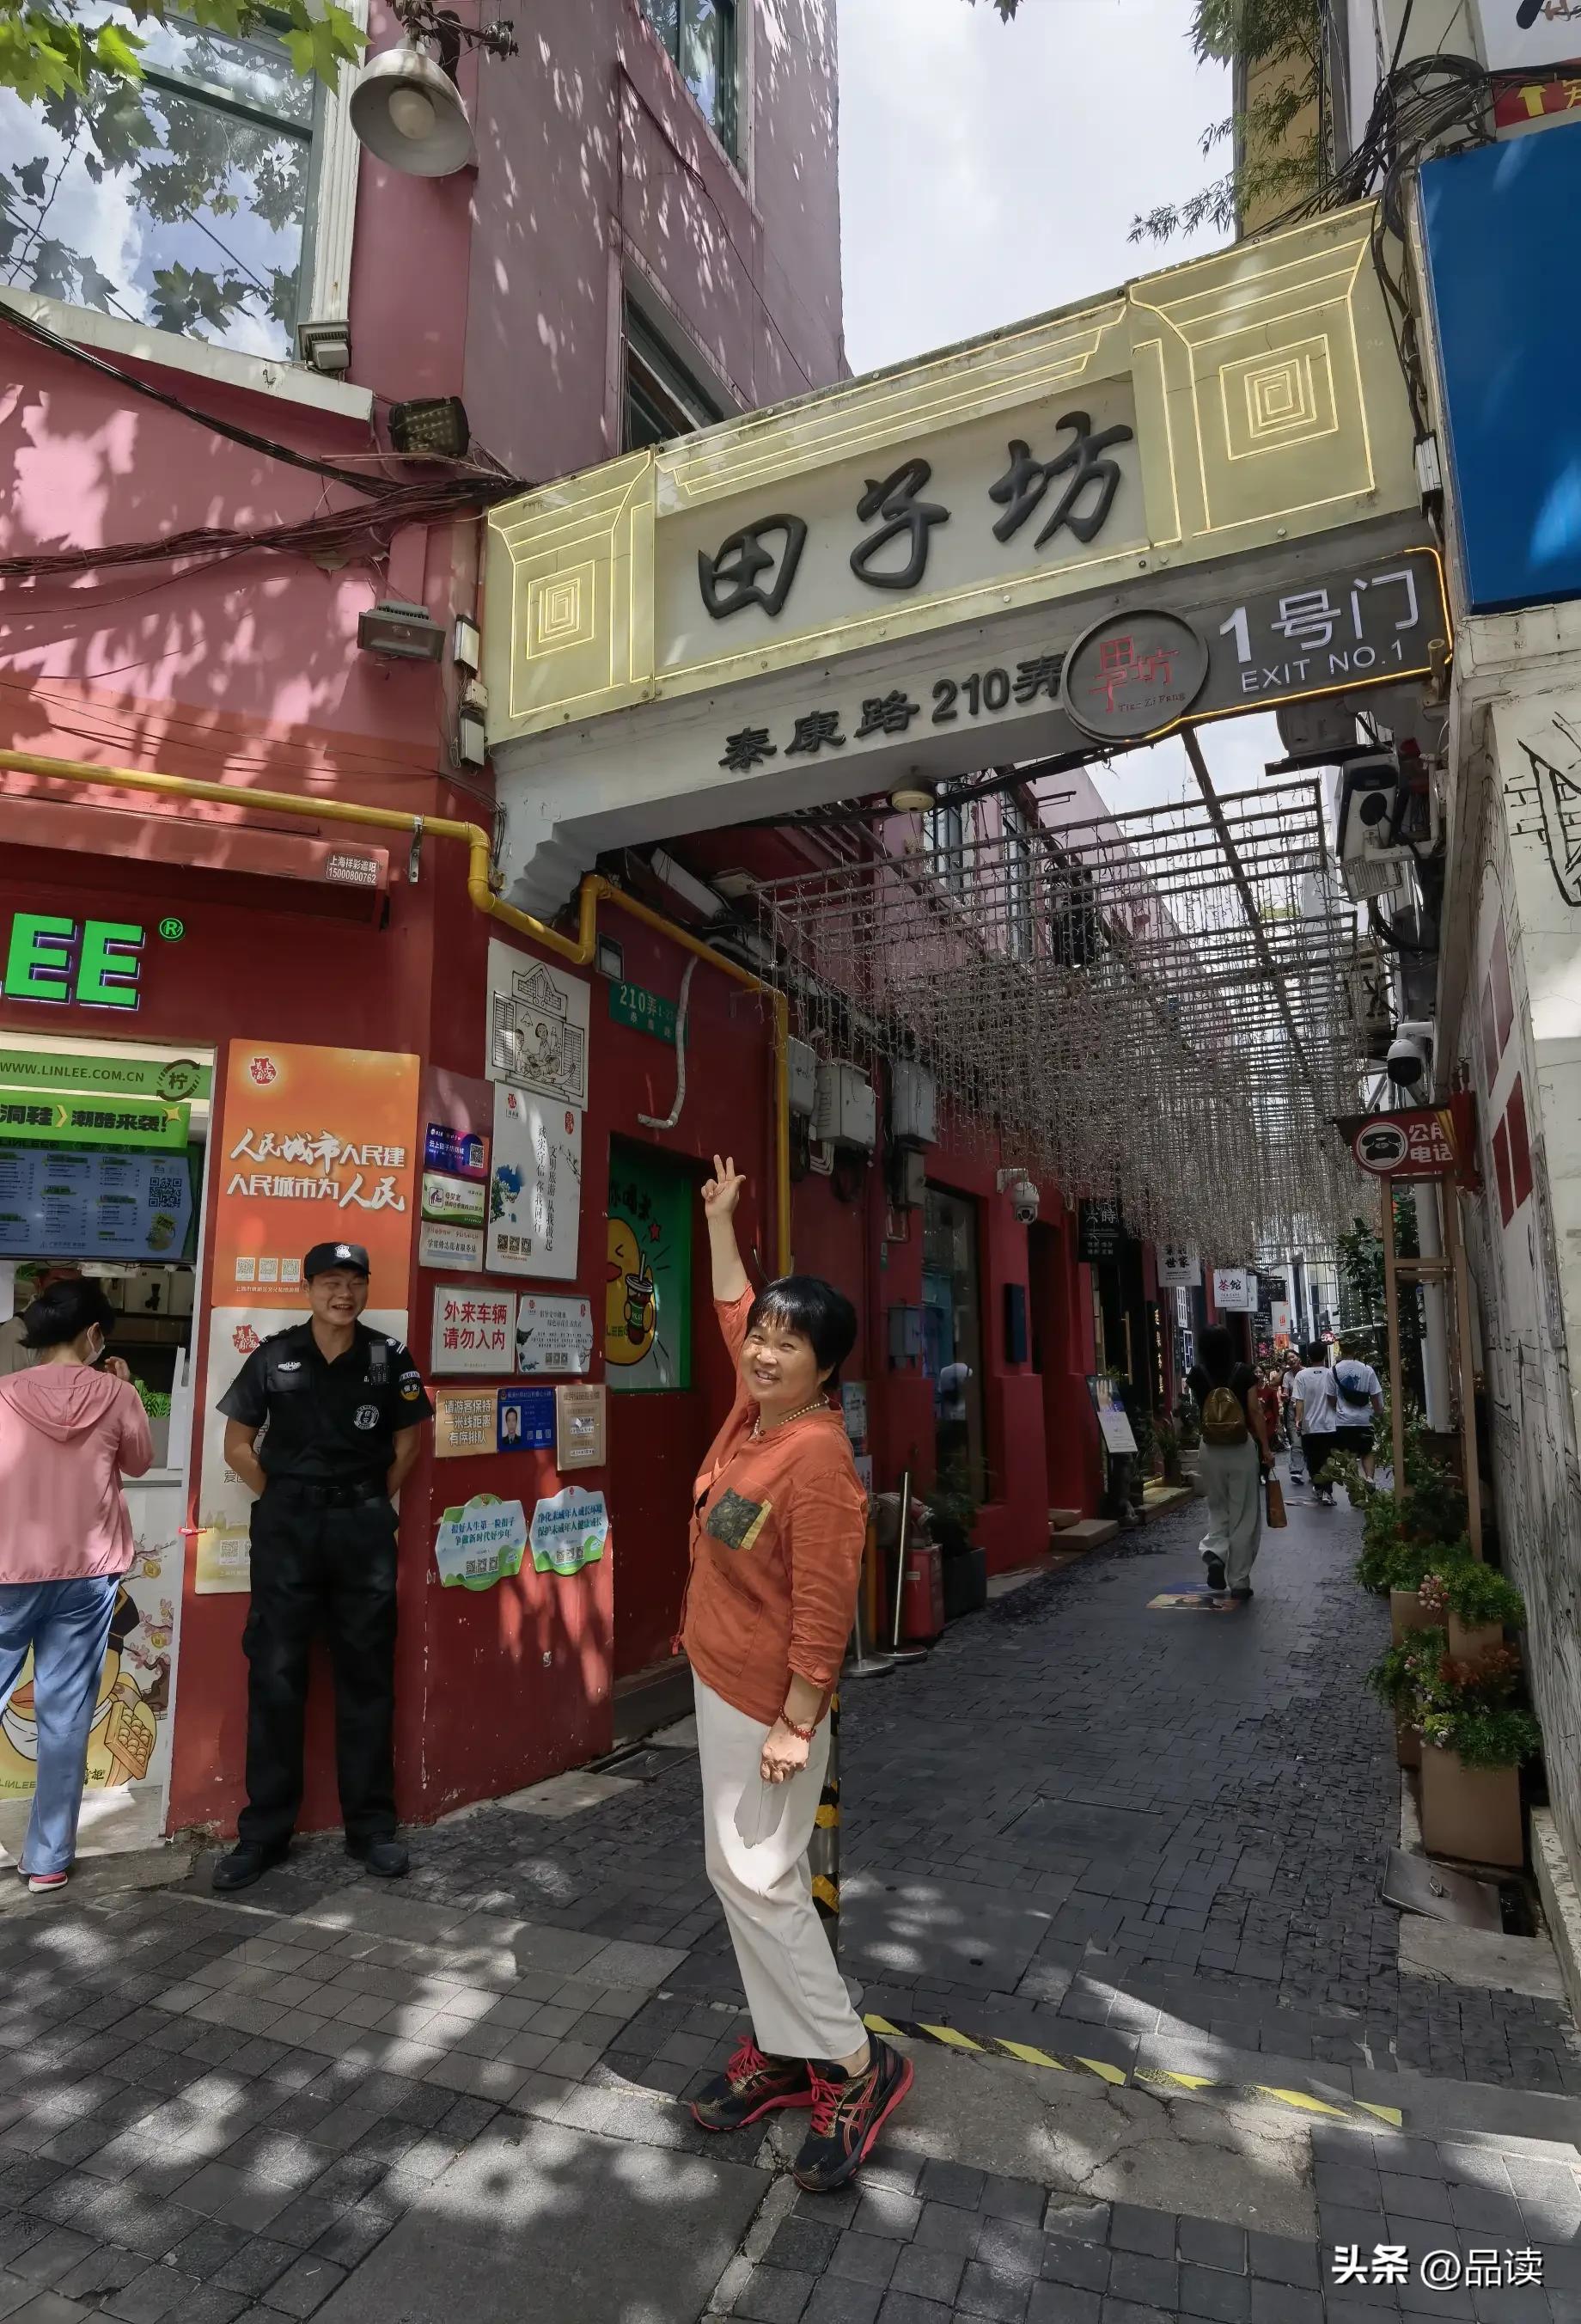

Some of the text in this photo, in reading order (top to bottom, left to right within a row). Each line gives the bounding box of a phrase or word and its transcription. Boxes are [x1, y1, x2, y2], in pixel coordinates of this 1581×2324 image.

[698, 410, 1133, 620] 田子坊
[1219, 569, 1419, 664] 1号门
[1242, 639, 1402, 693] EXIT NO.1
[718, 651, 1068, 771] 泰康路210弄
[329, 867, 376, 884] 15000800762
[0, 1061, 144, 1083] WWW.LINLEE.COM.CN
[229, 1128, 405, 1175] 人民城市人民建
[1410, 1143, 1453, 1163] 电话
[227, 1172, 405, 1211] 人民城市为人民
[444, 1300, 508, 1325] 外来车辆
[443, 1327, 505, 1350] 请勿入内
[444, 1399, 491, 1415] 请游客保持
[444, 1416, 491, 1429] 一米线距离
[449, 1431, 487, 1446] 有序排队
[451, 1516, 516, 1534] 扣好人生第一粒扣子
[455, 1529, 512, 1546] 争做新时代好少年
